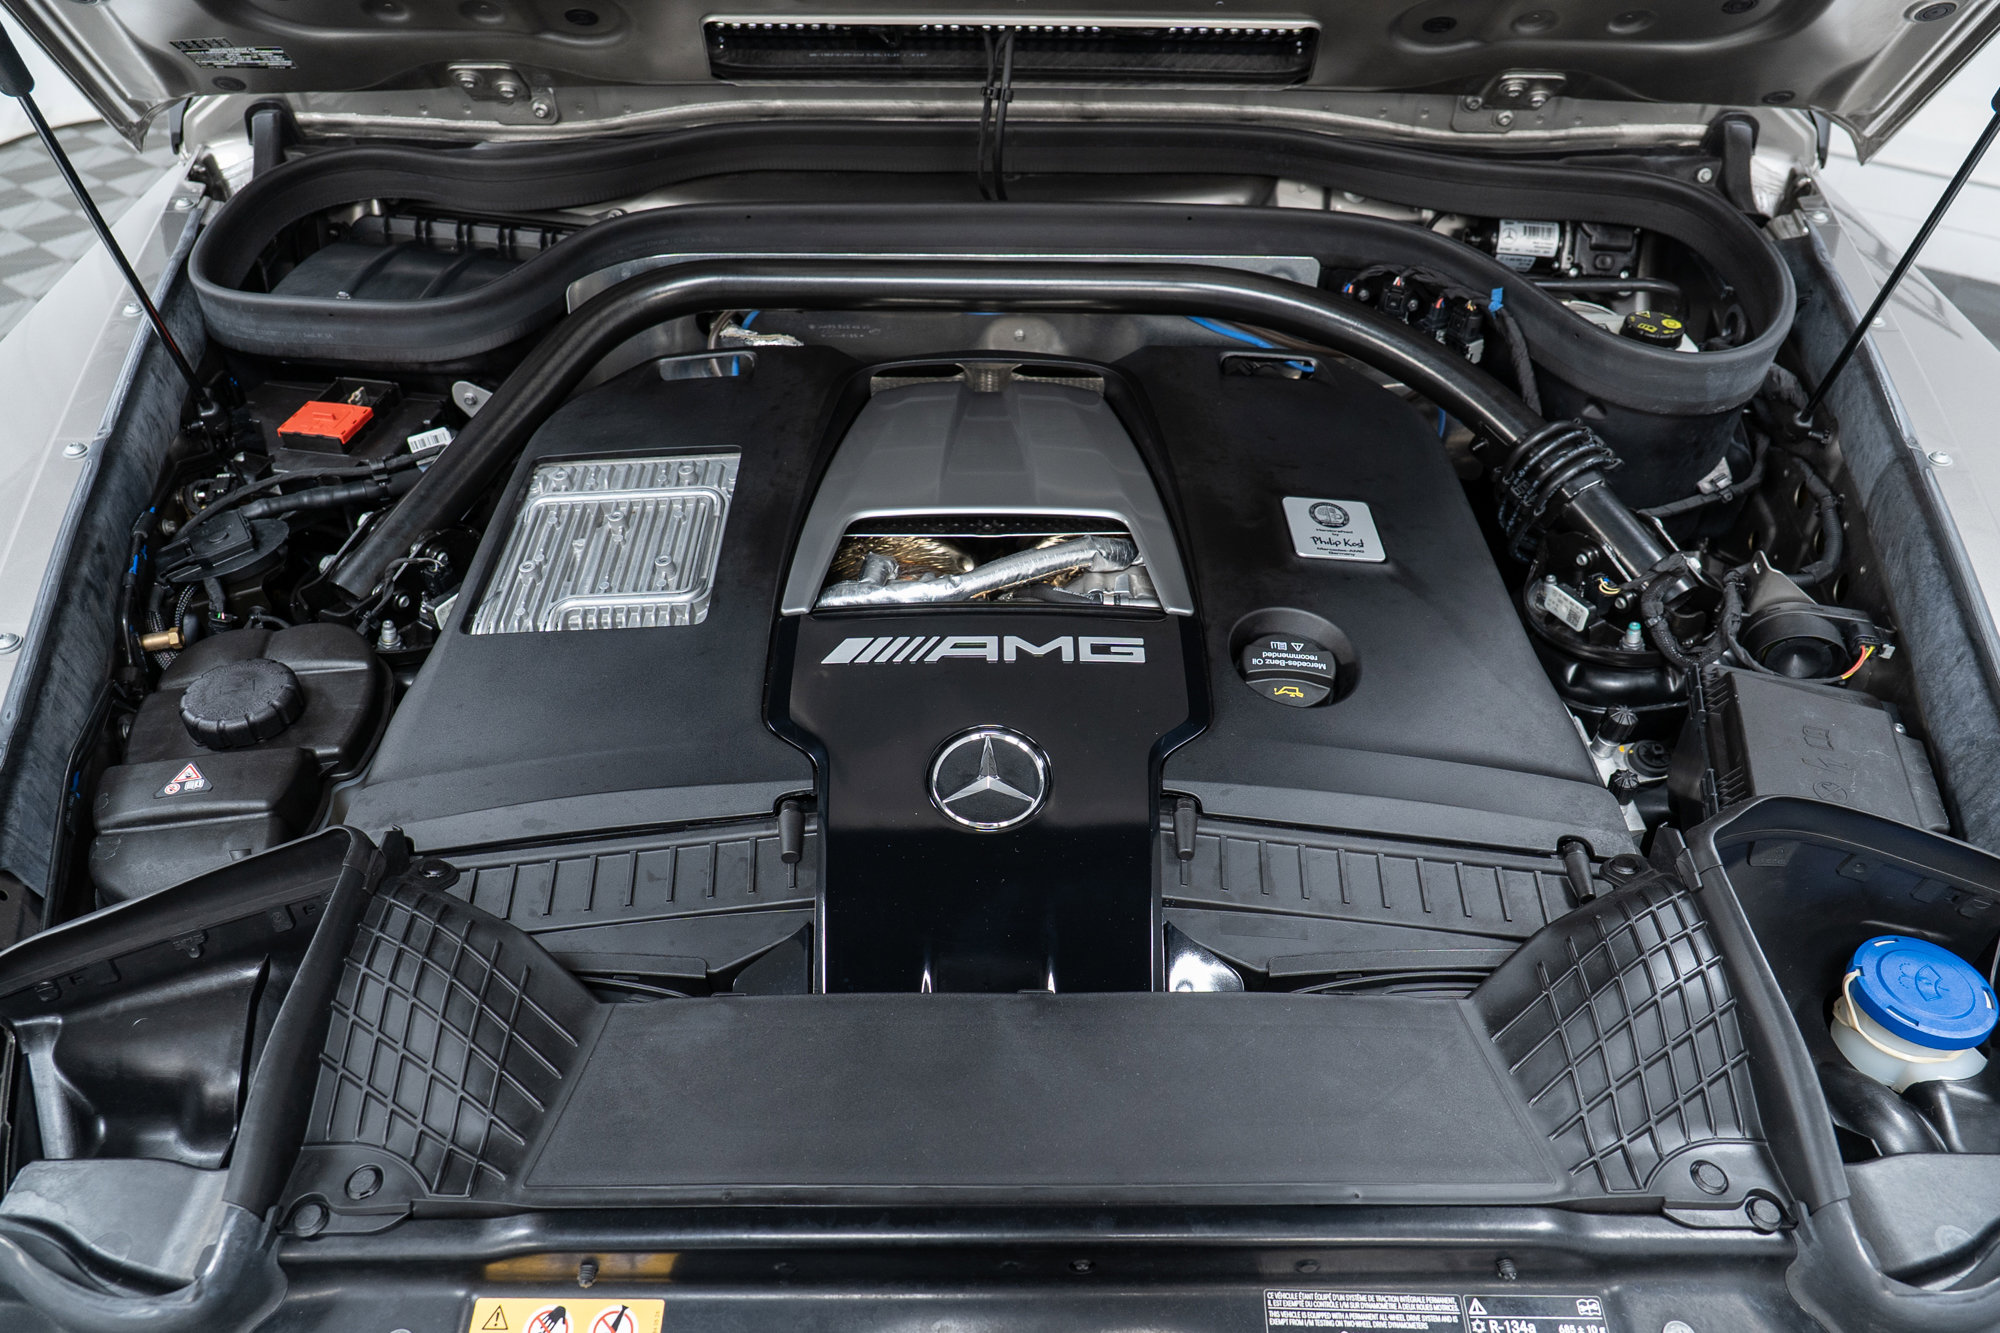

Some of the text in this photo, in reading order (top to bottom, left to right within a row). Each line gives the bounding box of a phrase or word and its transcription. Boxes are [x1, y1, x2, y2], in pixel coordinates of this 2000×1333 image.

[1310, 535, 1341, 547] Philip
[924, 636, 1145, 663] AMG
[1262, 651, 1318, 661] recommended
[1265, 658, 1326, 670] Mercedes-Benz
[1367, 1294, 1375, 1302] DE
[1268, 1310, 1280, 1318] THIS
[1280, 1310, 1301, 1318] VEHICLE
[1307, 1311, 1331, 1319] EQUIPPED
[1349, 1312, 1378, 1320] PERMANENT
[1441, 1315, 1452, 1323] AND
[1269, 1318, 1288, 1326] EXEMPT
[1288, 1318, 1304, 1326] FROM
[1488, 1319, 1537, 1333] R-134a
